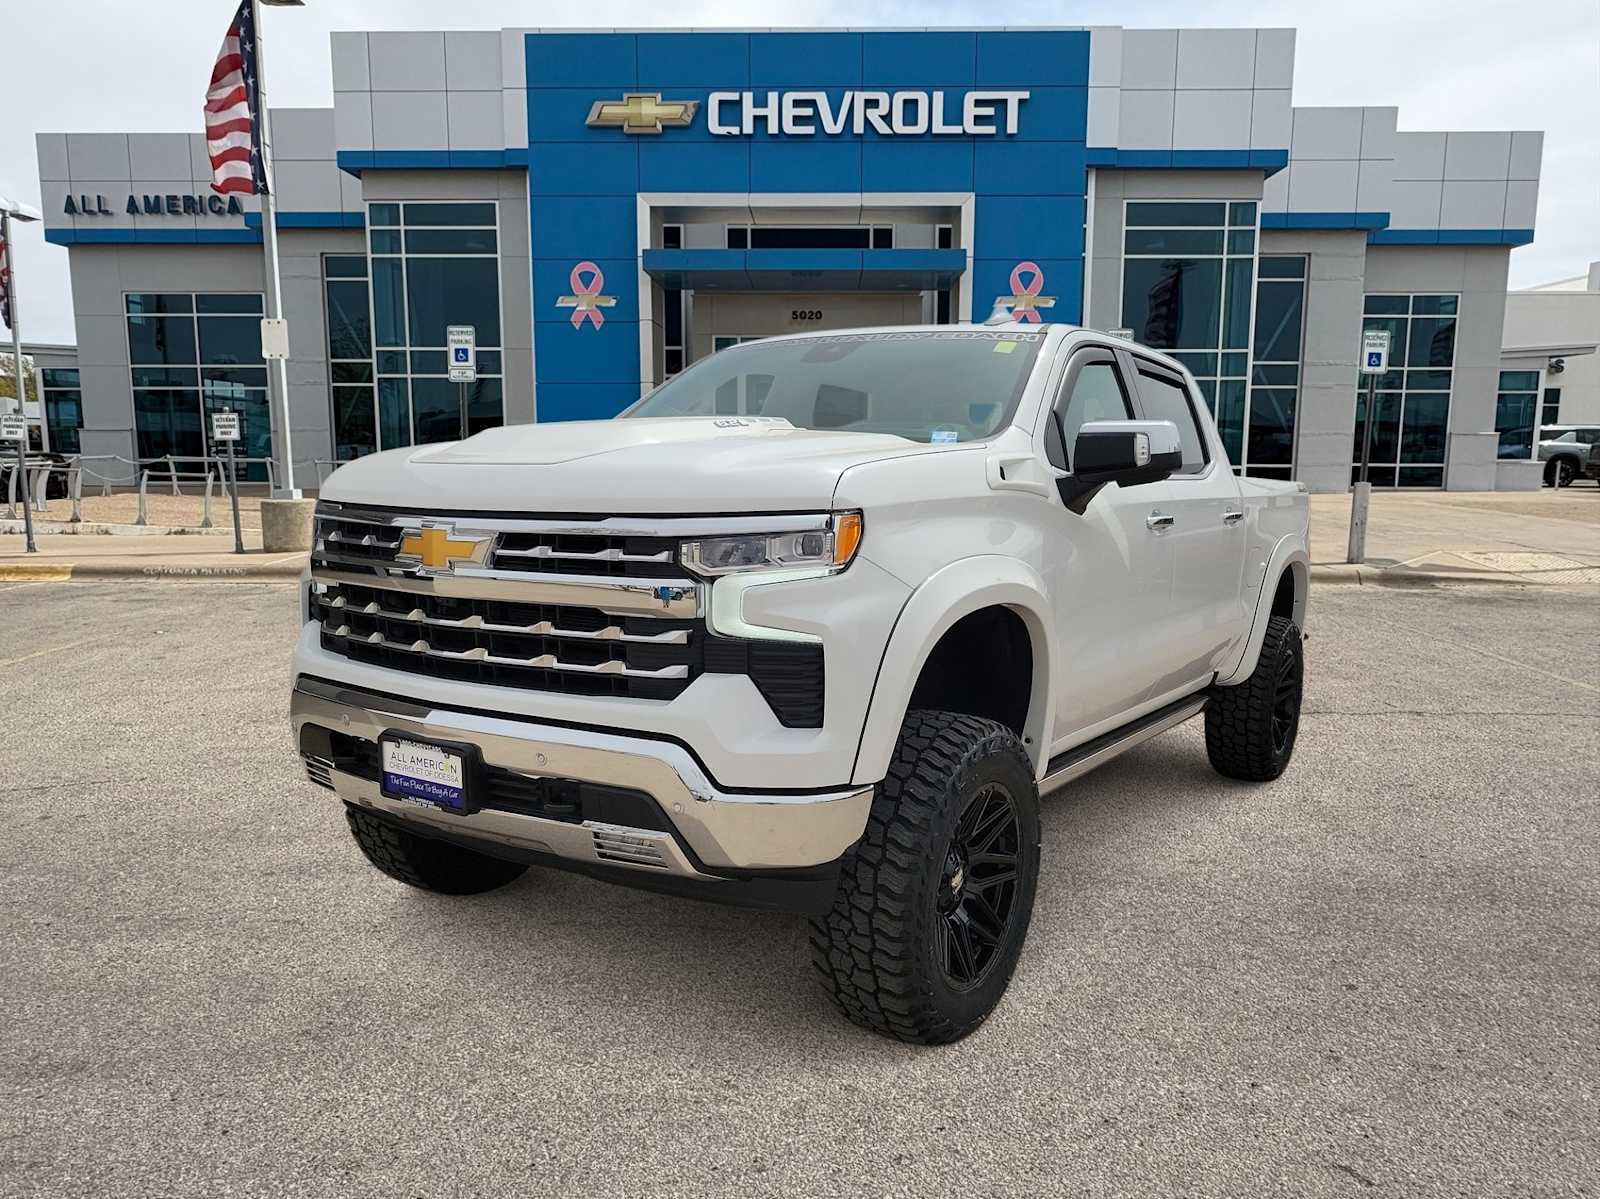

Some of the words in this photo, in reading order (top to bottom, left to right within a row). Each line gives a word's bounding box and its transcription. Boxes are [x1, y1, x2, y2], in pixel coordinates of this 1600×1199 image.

[707, 90, 1031, 135] CHEVROLET
[63, 194, 112, 215] ALL
[125, 194, 243, 215] AMERICA
[791, 310, 823, 320] 5020
[935, 331, 1040, 342] COACH
[391, 751, 408, 764] ALL
[410, 755, 458, 775] AMERICN
[390, 774, 400, 785] The
[410, 779, 424, 791] Place
[424, 783, 432, 793] To
[442, 788, 449, 797] A
[449, 788, 460, 799] Car
